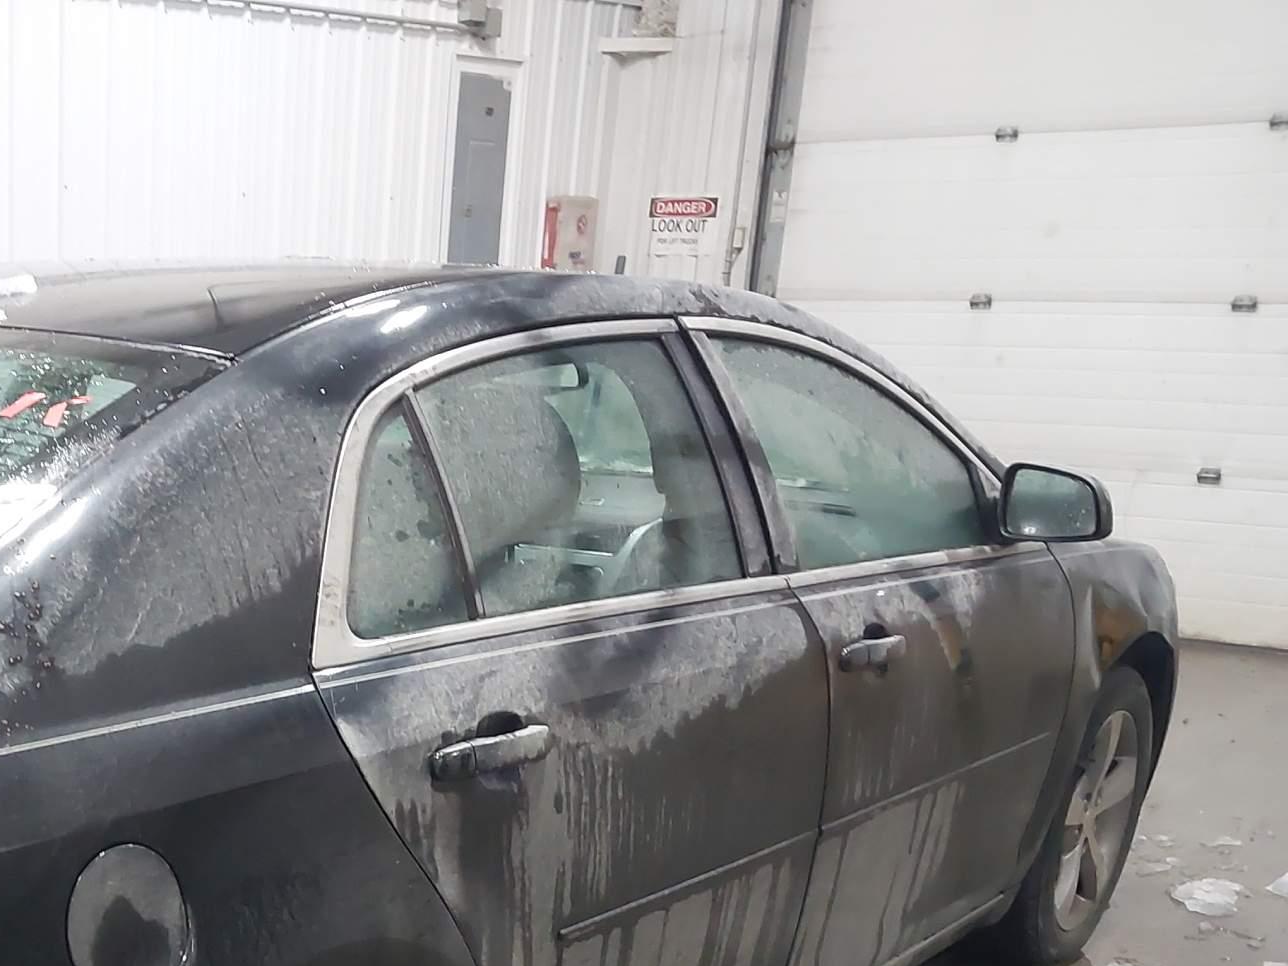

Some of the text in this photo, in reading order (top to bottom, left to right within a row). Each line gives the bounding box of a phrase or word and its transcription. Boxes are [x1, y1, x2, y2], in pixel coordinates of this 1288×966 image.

[656, 201, 707, 214] DANGER
[652, 219, 708, 233] LOOK OUT
